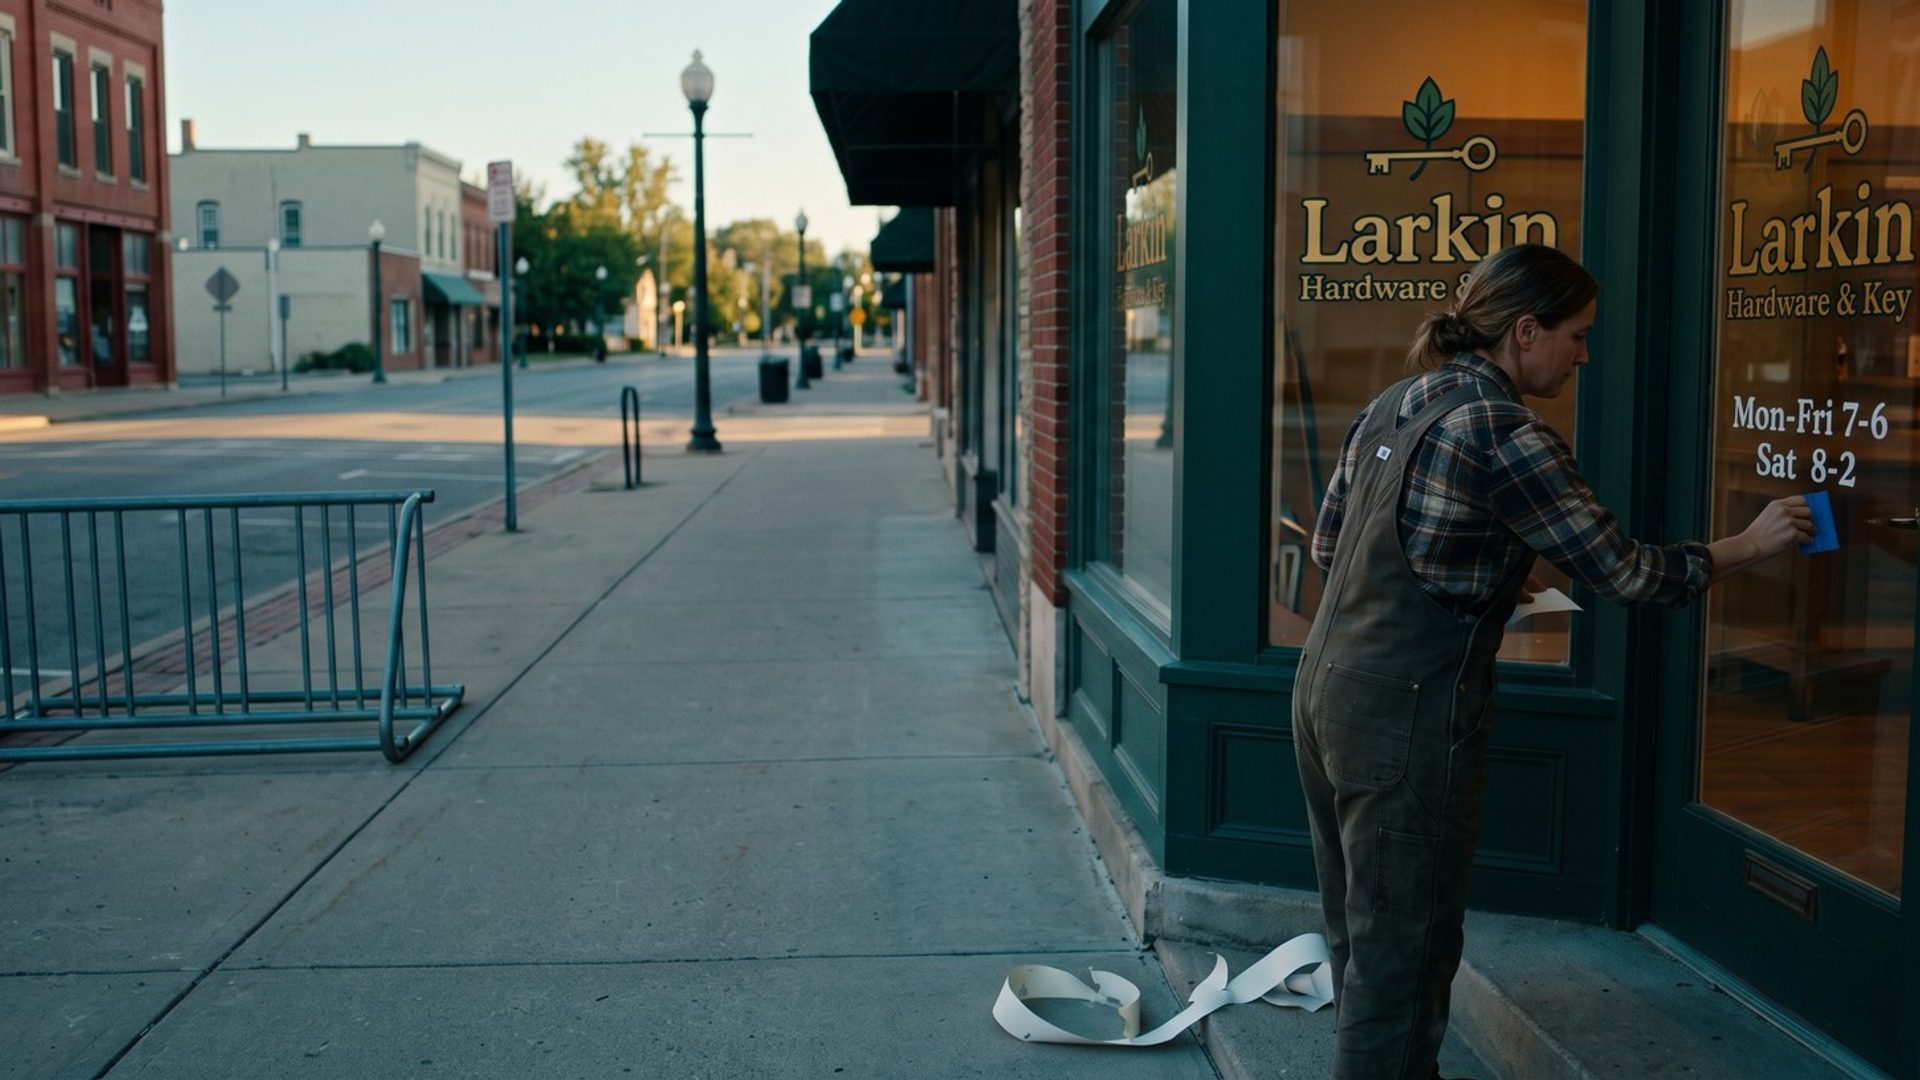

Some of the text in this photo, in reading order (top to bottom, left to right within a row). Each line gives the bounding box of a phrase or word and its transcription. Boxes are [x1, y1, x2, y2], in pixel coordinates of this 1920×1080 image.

[1301, 193, 1558, 263] Larkin
[1729, 182, 1915, 276] Larkin
[1300, 274, 1448, 300] Hardware
[1726, 280, 1913, 324] Hardware & Key
[1733, 396, 1889, 440] Mon-Fri 7-6
[1756, 442, 1857, 488] Sat 8-2
